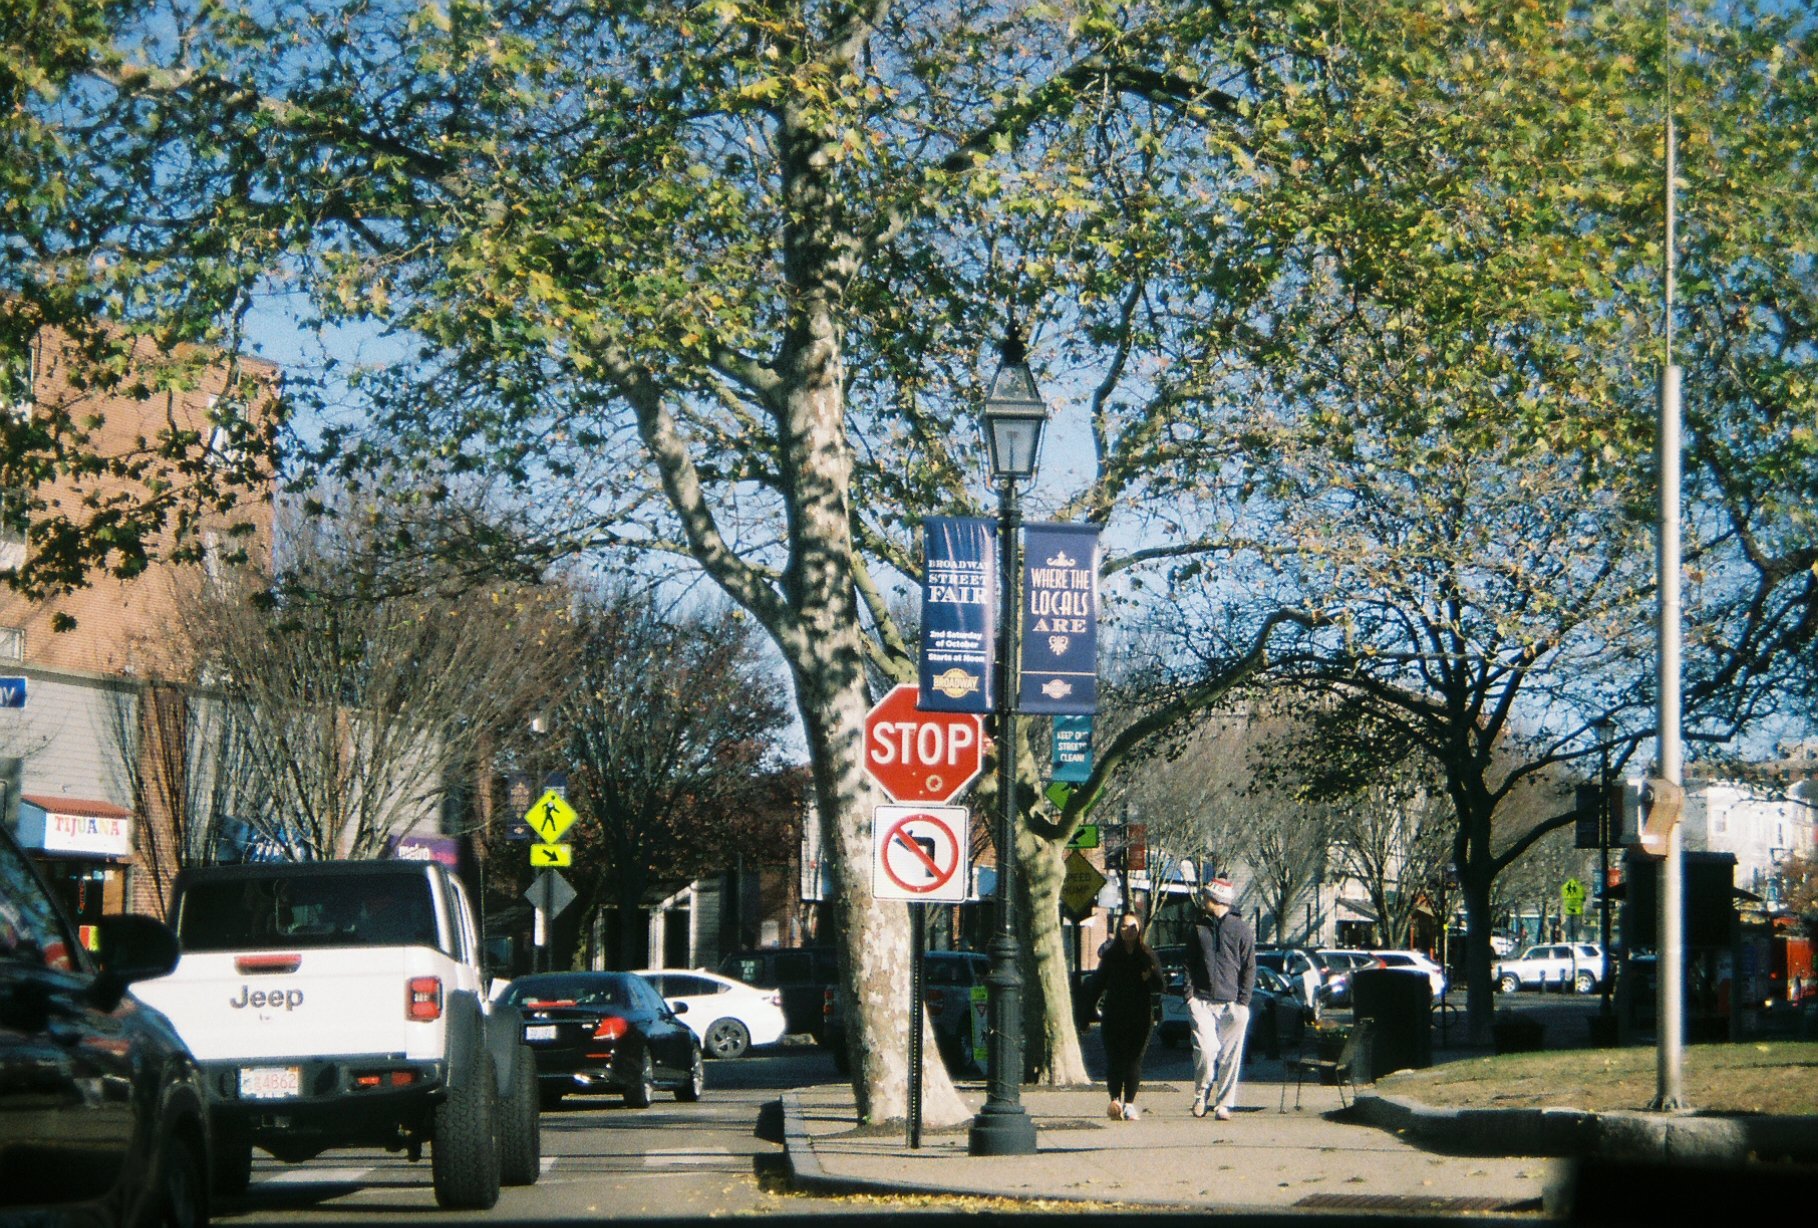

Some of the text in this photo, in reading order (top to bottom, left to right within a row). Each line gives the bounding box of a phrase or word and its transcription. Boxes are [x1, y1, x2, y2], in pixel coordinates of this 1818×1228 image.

[928, 574, 987, 585] STREET
[1031, 567, 1090, 590] WHERE THE
[928, 586, 988, 604] FAIR
[1031, 590, 1088, 616] LOCALS
[1031, 618, 1087, 633] ARE
[929, 629, 983, 641] 2nd Saturday
[935, 639, 979, 649] of October
[928, 653, 985, 663] Starts at Noon
[934, 676, 977, 688] BROADWAY
[1056, 730, 1074, 740] KEEP
[870, 721, 974, 765] STOP
[54, 815, 120, 837] TIJUANA
[229, 984, 304, 1011] Jeep
